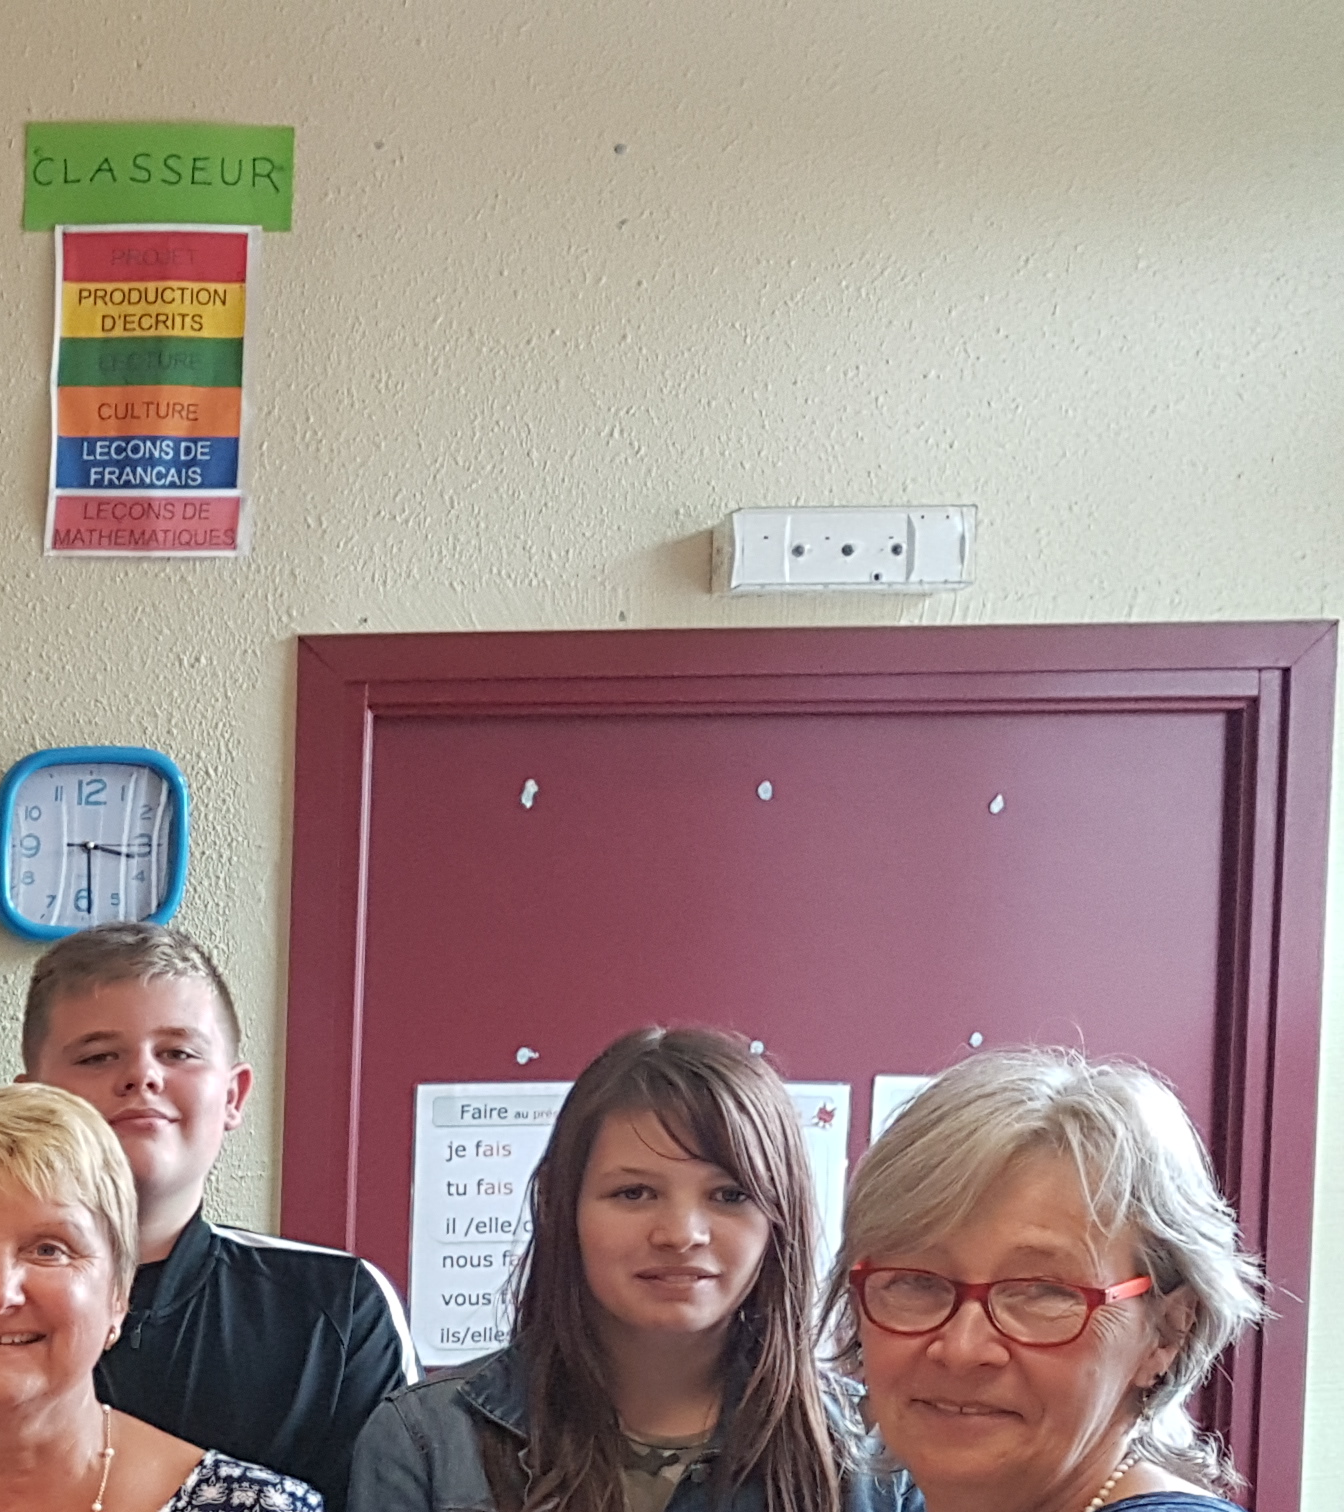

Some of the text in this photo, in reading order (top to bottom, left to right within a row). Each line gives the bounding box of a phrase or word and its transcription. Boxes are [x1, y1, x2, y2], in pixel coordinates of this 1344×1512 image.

[32, 153, 281, 193] CLASSEUR
[77, 286, 228, 307] PRODUCTION
[101, 312, 205, 333] D'ECRITS
[97, 401, 200, 422] CULTURE
[180, 441, 212, 461] DE
[181, 502, 212, 521] DE
[53, 528, 237, 548] MATHEMATIQUES
[76, 778, 108, 806] 12
[23, 805, 43, 822] 10
[140, 805, 153, 820] 2
[19, 833, 41, 859] 9
[20, 870, 36, 886] 8
[45, 895, 57, 909] 7
[459, 1103, 509, 1121] Faire
[514, 1111, 529, 1119] au
[445, 1140, 512, 1162] je fais
[446, 1178, 514, 1196] tu fais
[445, 1217, 457, 1235] il
[442, 1253, 494, 1269] nous
[441, 1292, 492, 1307] vous
